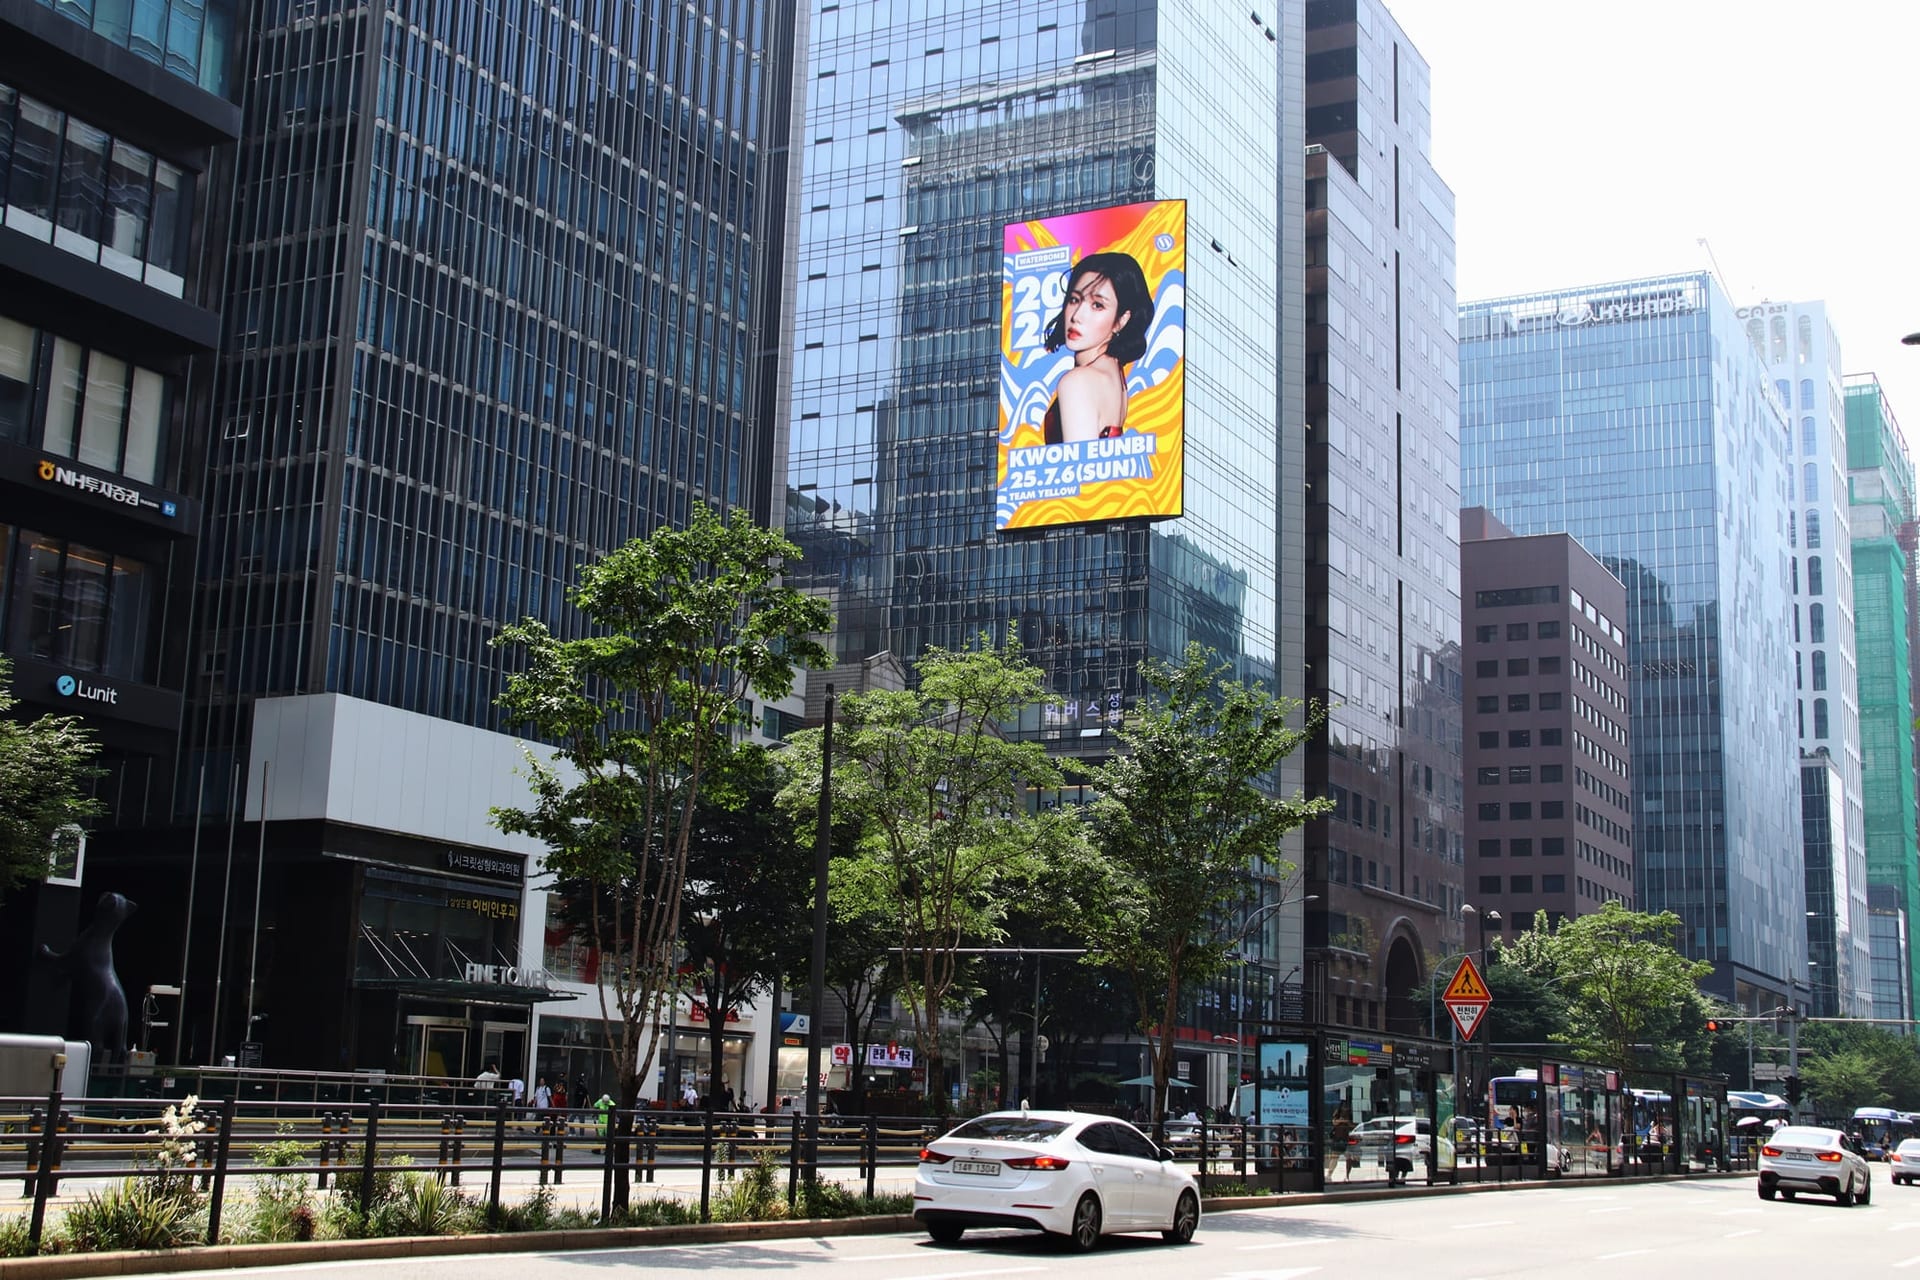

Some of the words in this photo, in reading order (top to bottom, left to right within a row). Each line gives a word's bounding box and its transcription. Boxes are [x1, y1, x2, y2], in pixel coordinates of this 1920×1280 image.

[1019, 251, 1066, 265] WATERBOMB
[1014, 271, 1068, 313] 20
[1010, 443, 1079, 468] KWON
[1087, 435, 1154, 459] EUNBI
[1010, 457, 1137, 489] 25.7.6(SUN)
[56, 467, 139, 506] NH투자증권
[1009, 489, 1036, 501] TEAM
[1038, 486, 1077, 498] YELLOW
[78, 680, 117, 704] Lunit
[454, 854, 520, 876] 시크릿성형외과의원
[465, 963, 498, 984] FINE
[1457, 1006, 1478, 1015] 천천히
[834, 1046, 850, 1064] 약
